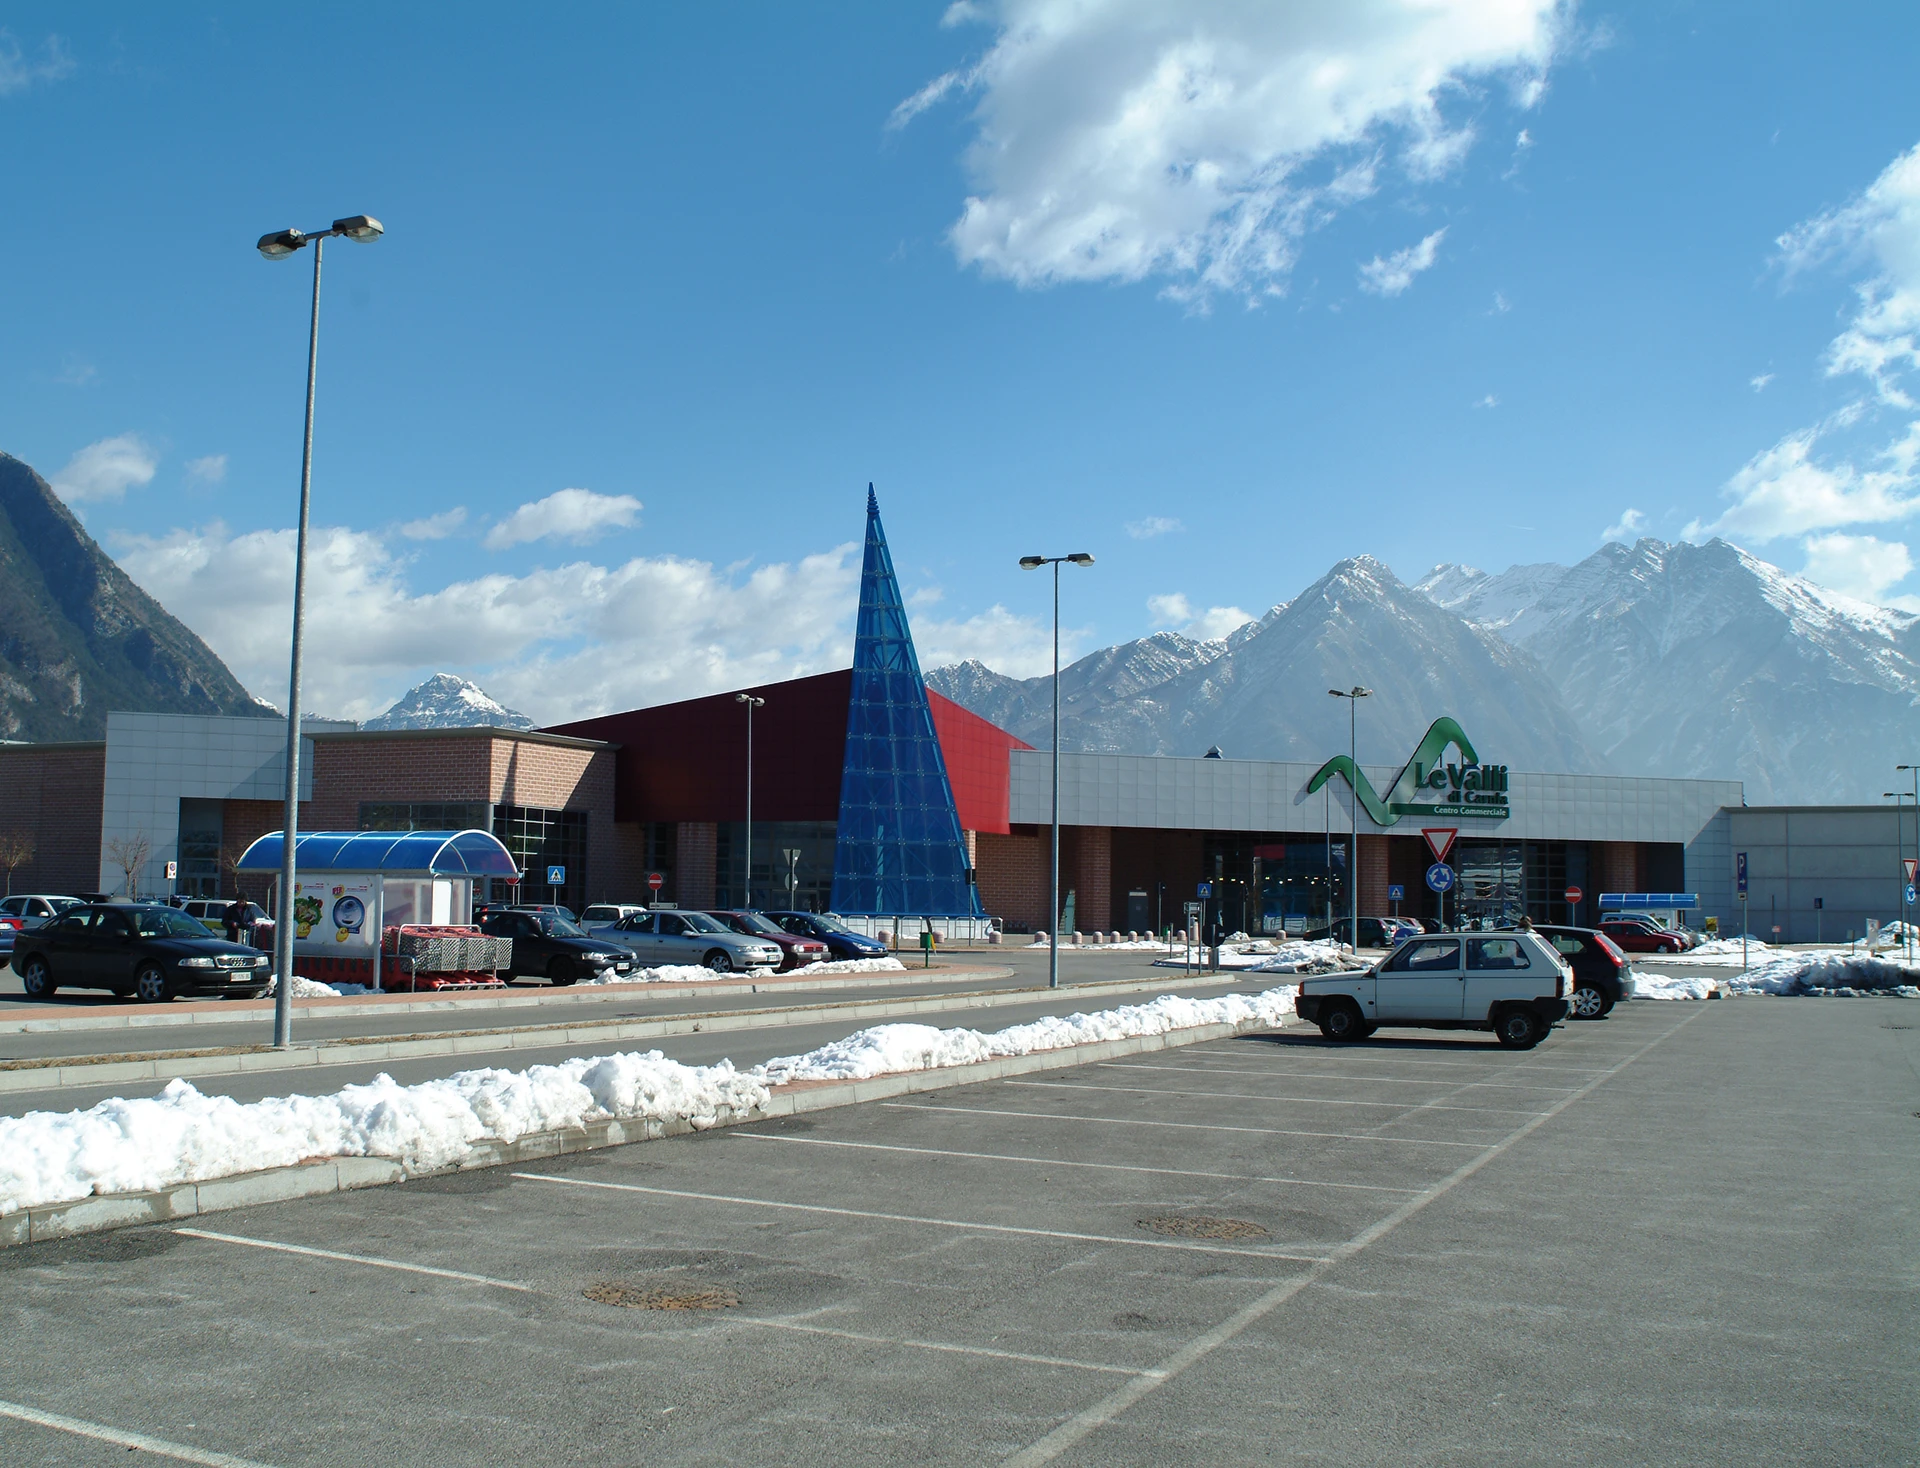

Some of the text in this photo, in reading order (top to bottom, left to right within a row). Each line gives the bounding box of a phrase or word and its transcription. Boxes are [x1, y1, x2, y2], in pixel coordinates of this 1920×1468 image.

[1447, 790, 1508, 804] di Carnia
[1434, 806, 1507, 816] Centro Commerciale
[1739, 855, 1745, 873] P
